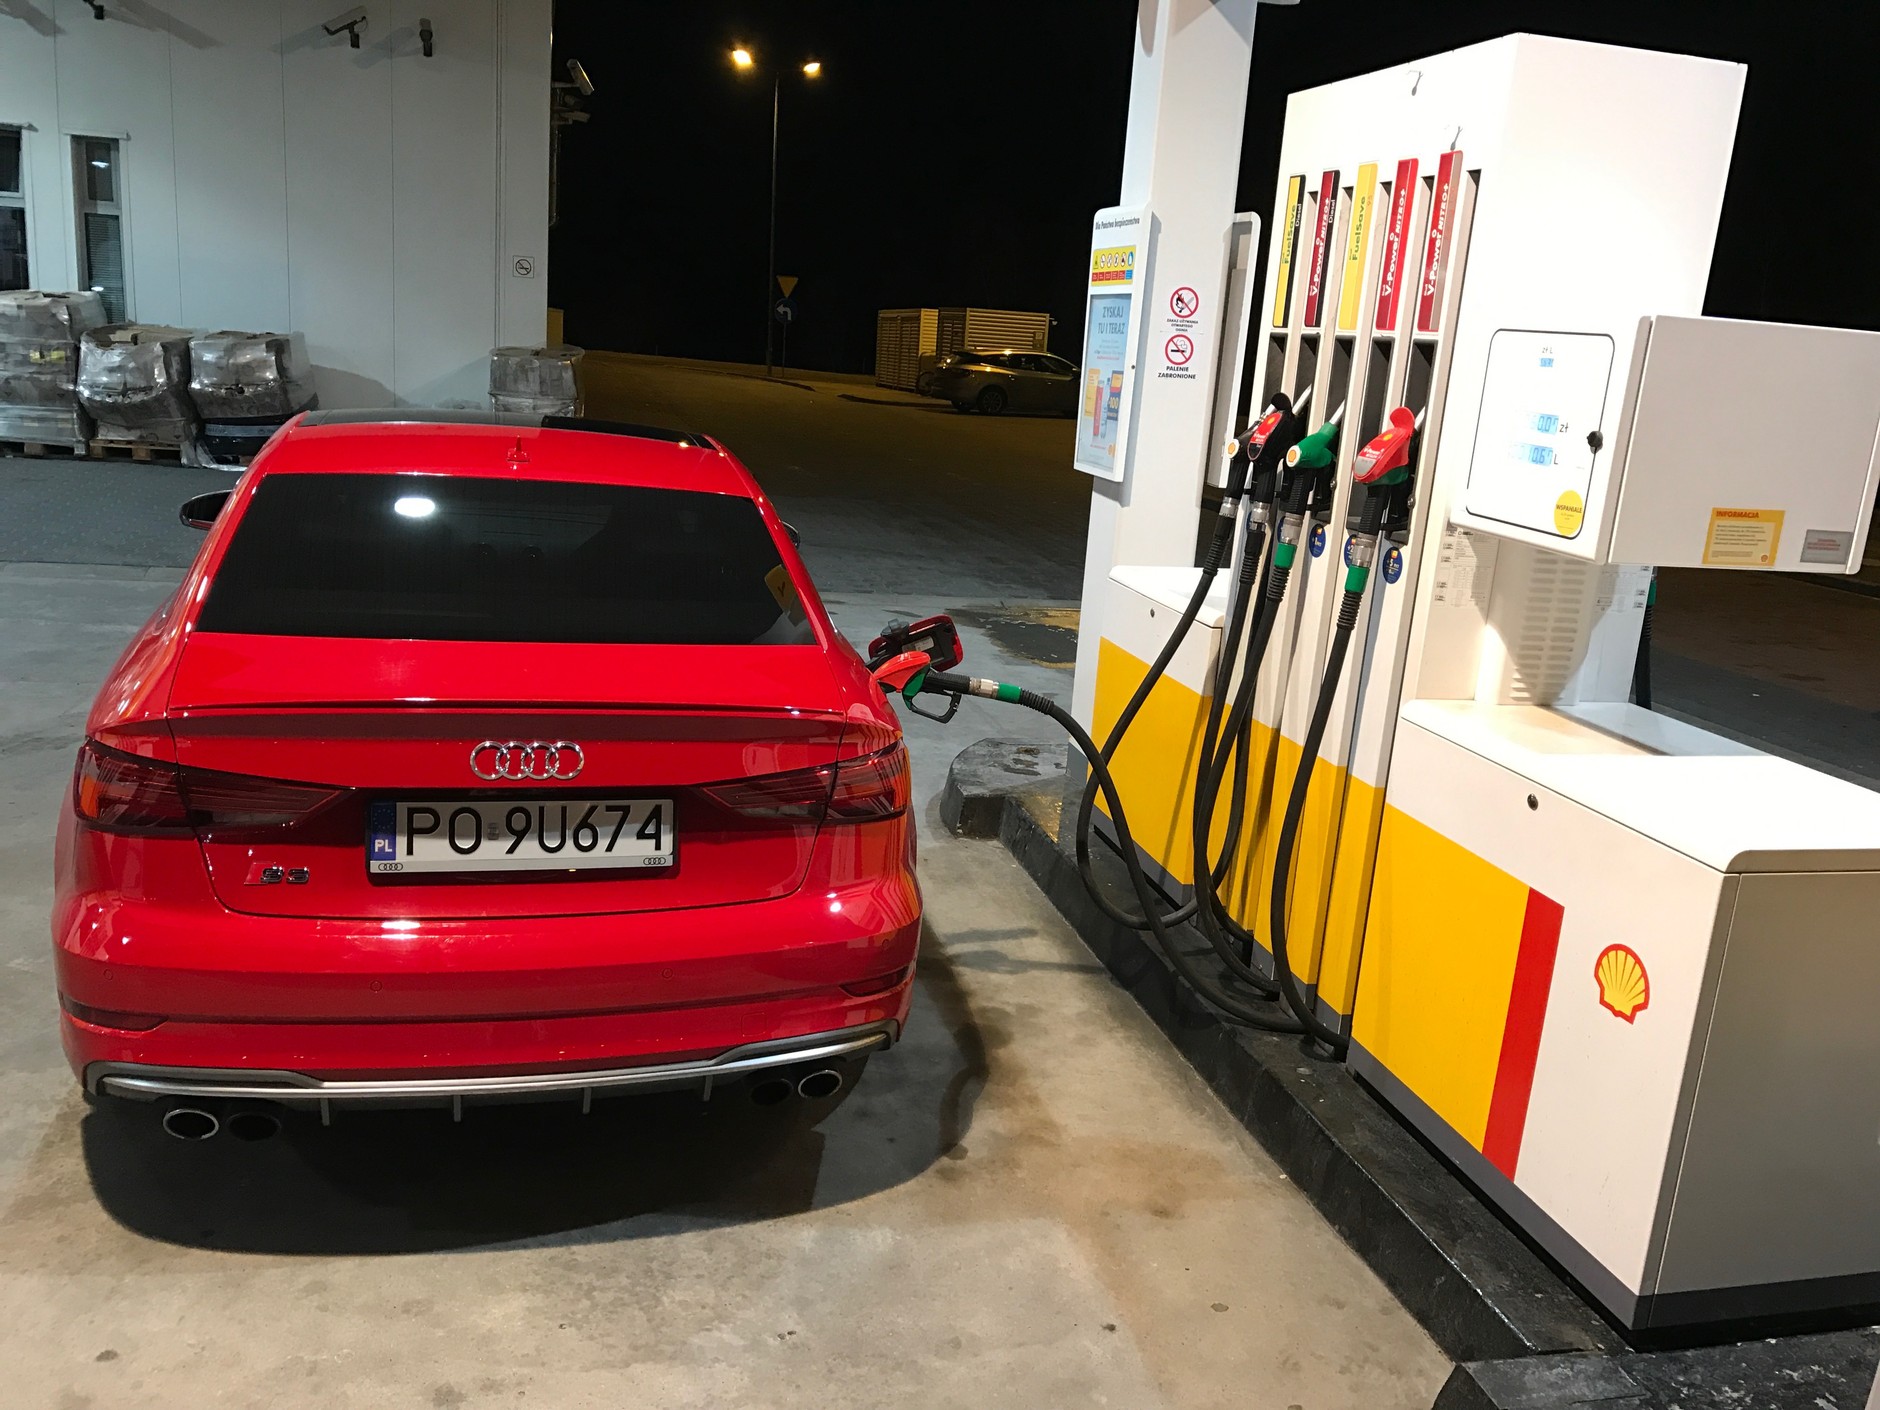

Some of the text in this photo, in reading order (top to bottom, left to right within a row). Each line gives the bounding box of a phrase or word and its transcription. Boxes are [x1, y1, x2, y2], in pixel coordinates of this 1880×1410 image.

[1284, 204, 1296, 265] FuelSave
[1312, 198, 1330, 296] V-Power NITRO+
[1352, 196, 1366, 261] FuelSave
[1384, 188, 1406, 296] V-Power NITRO+
[1427, 183, 1449, 296] V-Power NITRO+
[1102, 305, 1124, 318] ZYSKAJ
[1109, 322, 1126, 335] TERAZ
[1157, 372, 1197, 380] ZABRONIONE
[374, 839, 393, 853] PL
[406, 804, 664, 856] PO 9U674
